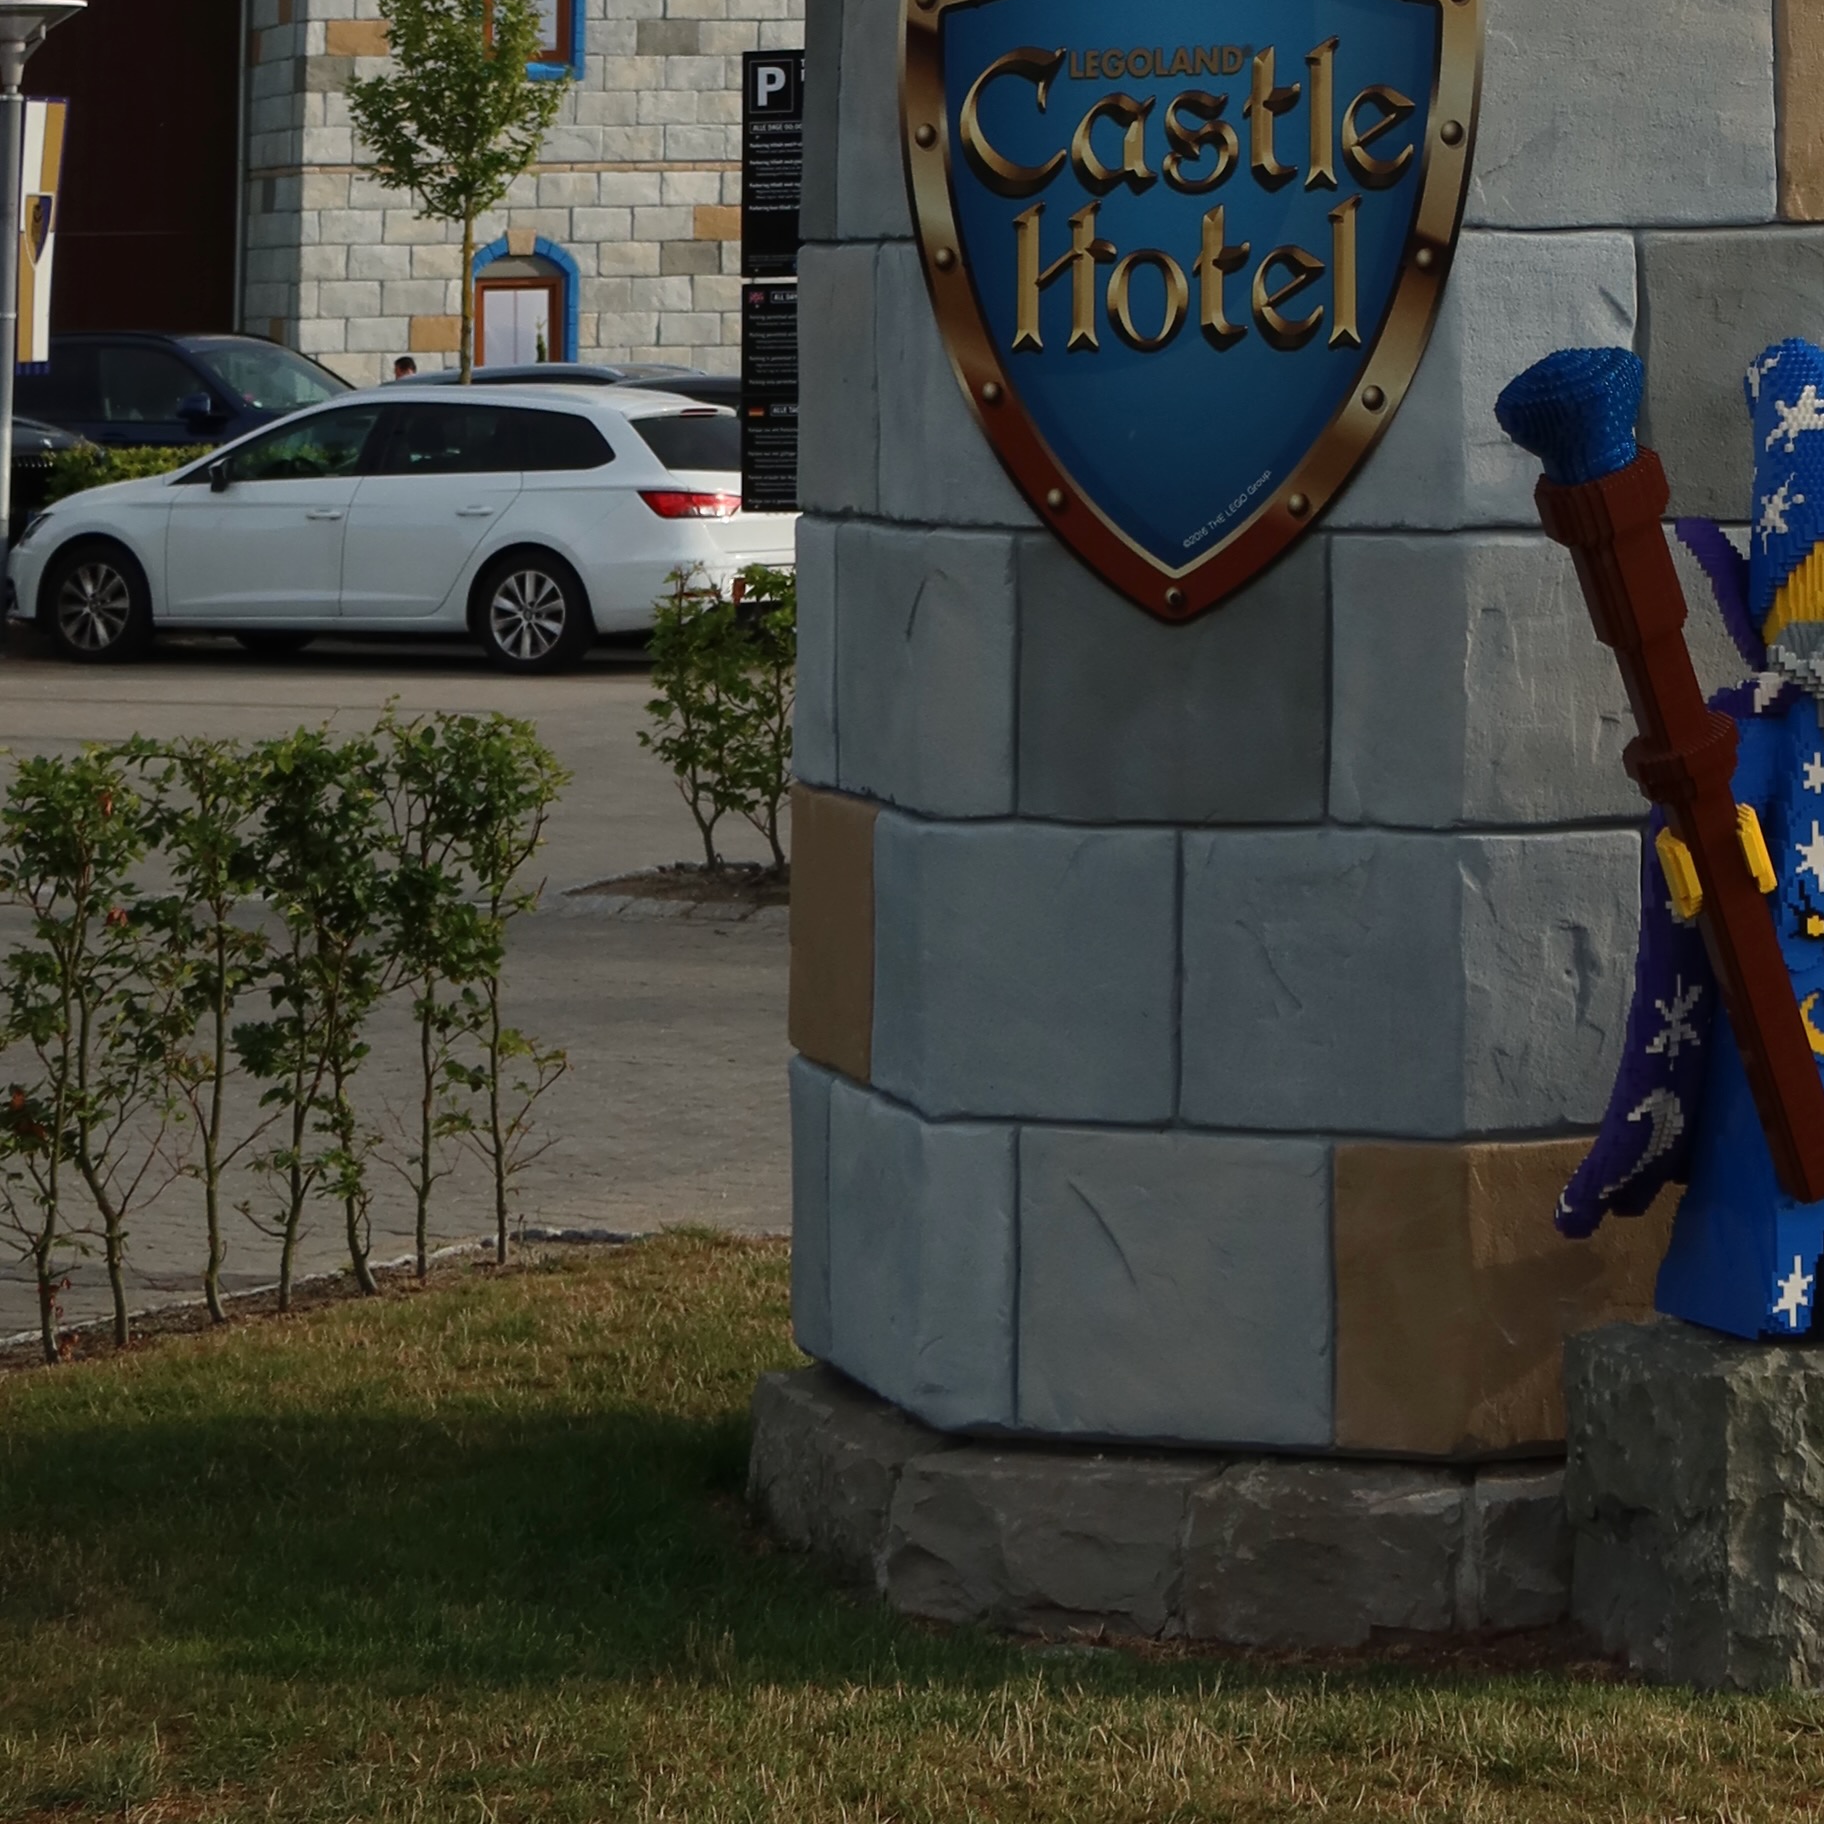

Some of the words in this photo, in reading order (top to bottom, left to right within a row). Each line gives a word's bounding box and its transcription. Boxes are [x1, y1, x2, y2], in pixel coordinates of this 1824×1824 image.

[757, 66, 787, 107] P
[959, 35, 1416, 197] Castle
[1011, 193, 1364, 353] Hotel
[1208, 513, 1226, 530] THE
[1225, 493, 1248, 517] LEGO
